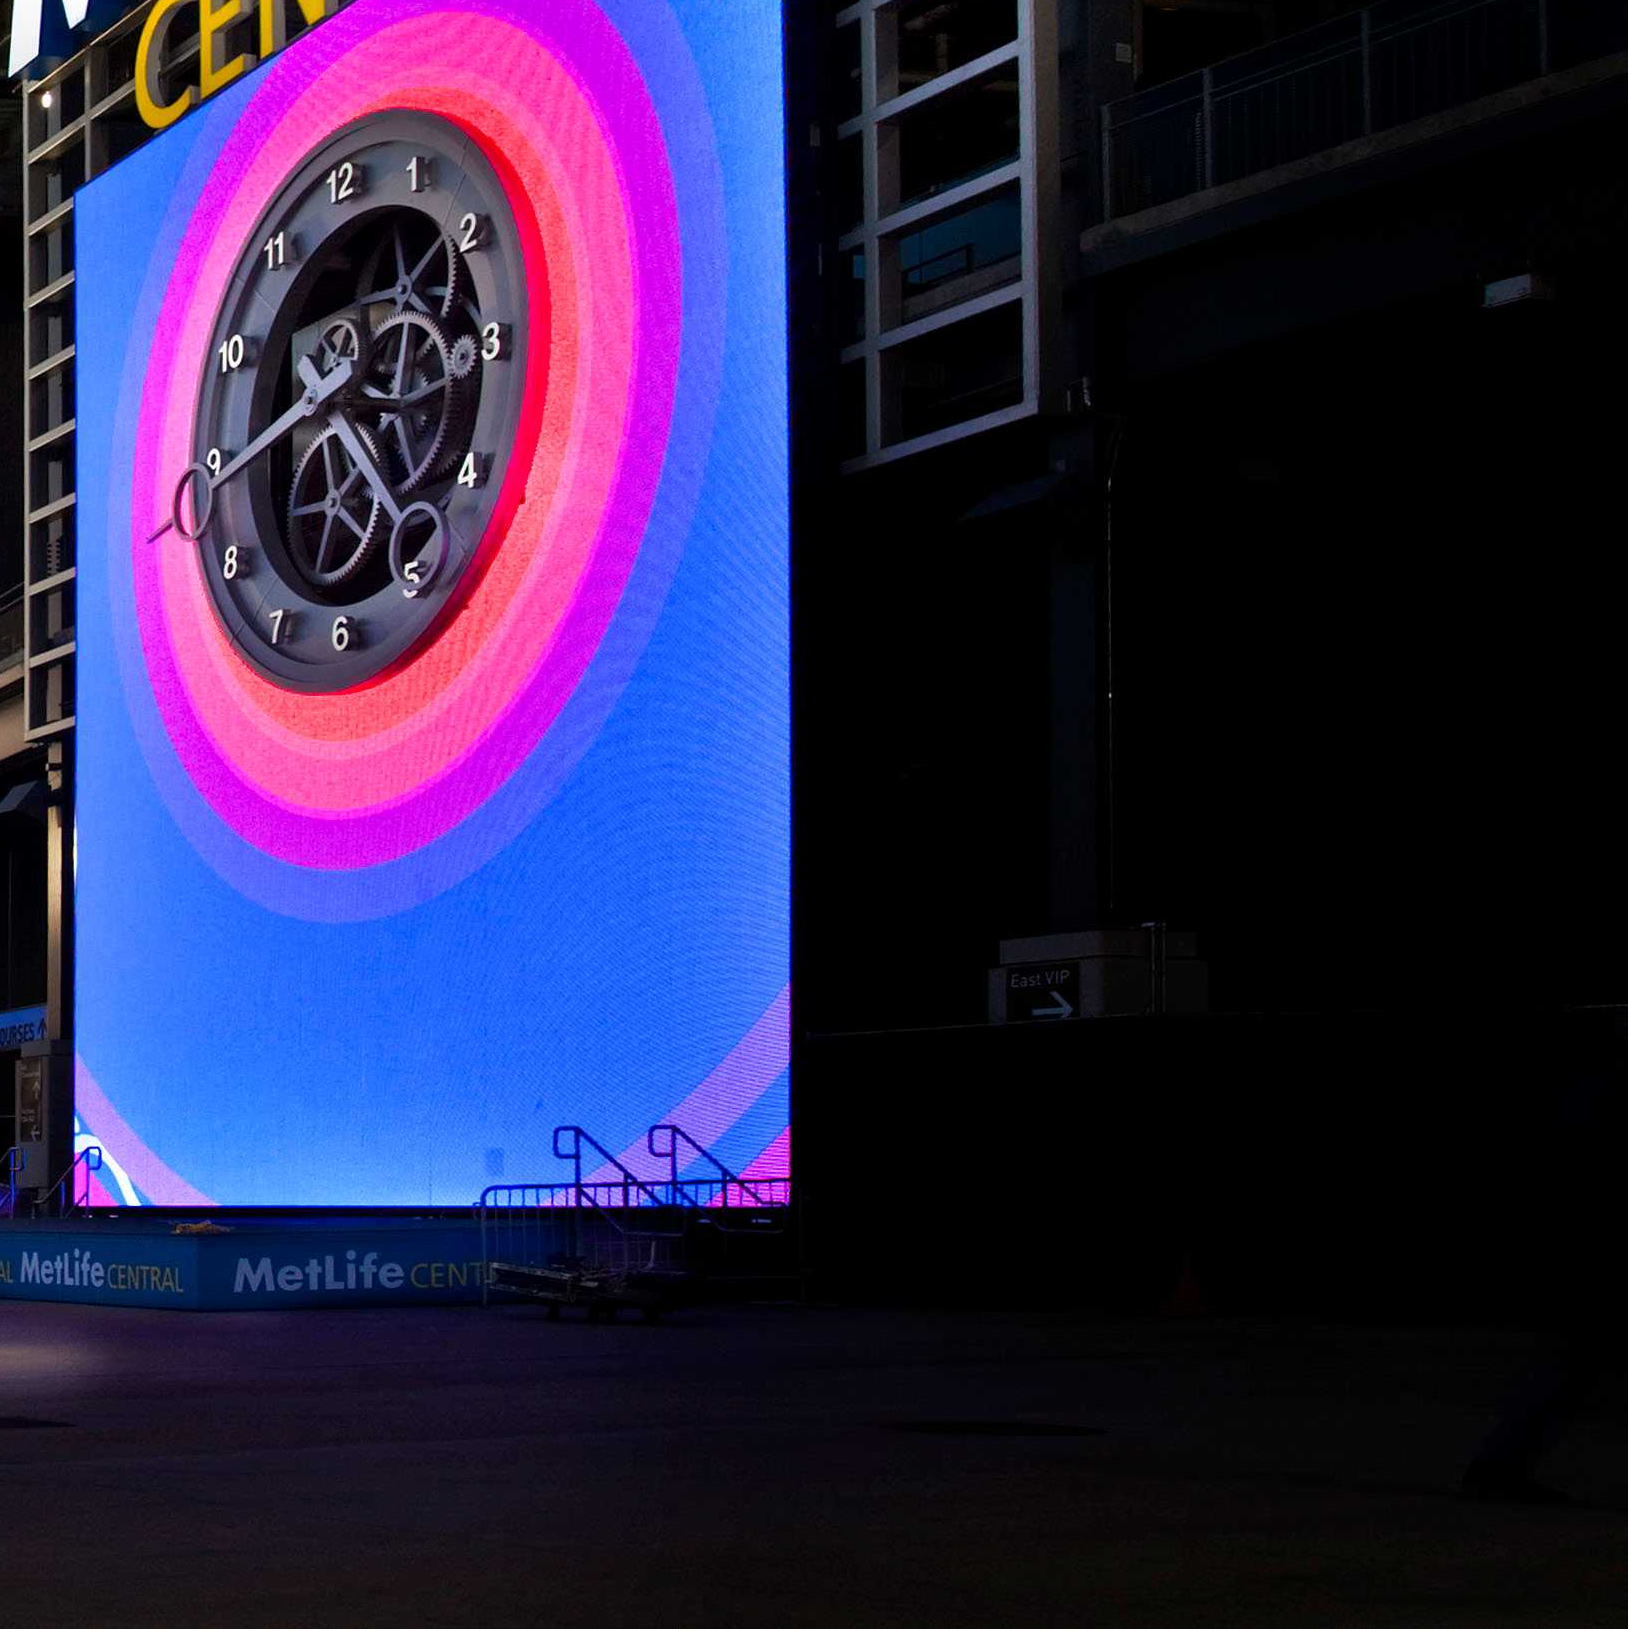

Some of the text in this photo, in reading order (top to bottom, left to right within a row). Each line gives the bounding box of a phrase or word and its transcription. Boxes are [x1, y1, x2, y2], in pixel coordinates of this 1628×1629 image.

[326, 162, 355, 203] 12
[406, 159, 422, 192] 1
[264, 231, 288, 267] 11
[459, 213, 480, 253] 2
[218, 334, 246, 373] 10
[481, 322, 501, 361] 3
[206, 447, 222, 479] 9
[457, 453, 477, 489] 4
[223, 546, 239, 581] 8
[269, 609, 285, 646] 7
[331, 615, 349, 652] 6
[1045, 969, 1072, 985] VIP
[20, 1247, 184, 1294] MetLife CENTRAL
[233, 1249, 405, 1294] MetLife
